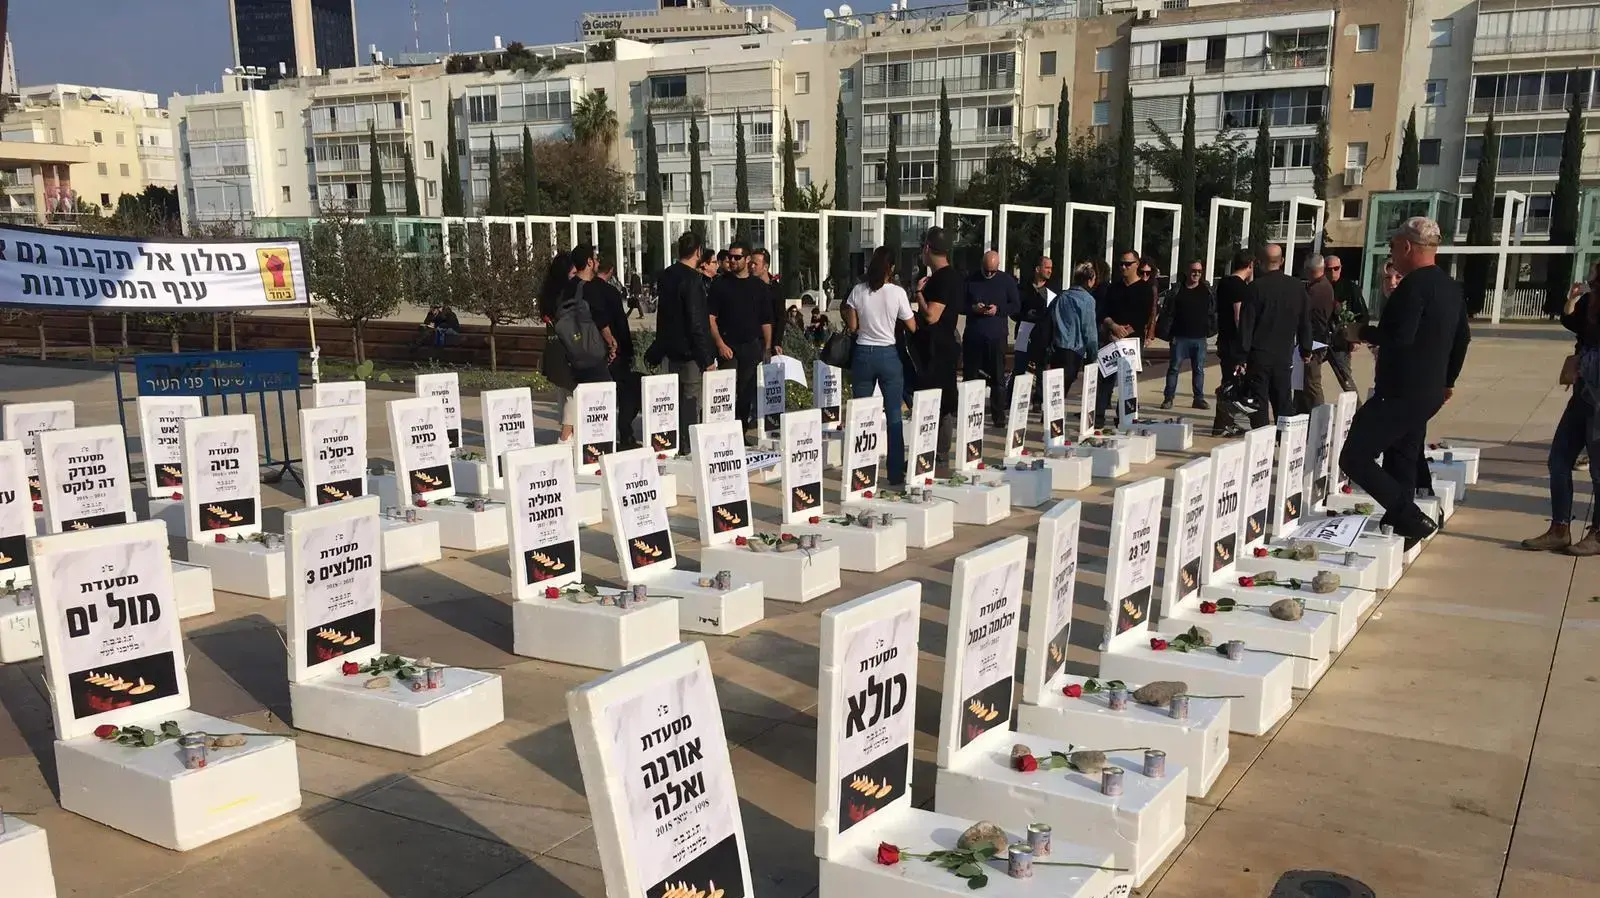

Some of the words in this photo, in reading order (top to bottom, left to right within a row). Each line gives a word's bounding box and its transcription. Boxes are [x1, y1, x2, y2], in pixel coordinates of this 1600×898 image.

[592, 19, 622, 30] Guesty
[16, 240, 48, 265] גם
[59, 245, 134, 274] תקבור
[139, 246, 173, 271] אל
[183, 248, 247, 276] כחלון
[21, 273, 156, 299] המסעדנות
[162, 281, 208, 304] ענף
[146, 378, 180, 392] העיר
[184, 376, 204, 389] פני
[411, 424, 434, 433] מסעדת
[323, 435, 349, 444] מסעדת
[411, 432, 437, 445] כתית
[68, 453, 104, 465] מסעדת
[208, 447, 240, 456] מסעדת
[714, 449, 734, 459] מסעדת
[68, 464, 107, 481] פונדק
[210, 459, 240, 472] בויה
[62, 478, 95, 495] לוקס
[98, 477, 116, 489] דה
[529, 478, 559, 491] מסעדת
[625, 479, 649, 490] מסעדת
[528, 492, 563, 508] אמיליה
[622, 496, 630, 507] 5
[630, 490, 657, 505] סינמה
[528, 506, 565, 523] רומאנה
[320, 542, 359, 560] מסעדת
[1129, 545, 1139, 562] 23
[320, 554, 372, 581] החלוצים
[80, 574, 139, 594] מסעדת
[306, 570, 316, 585] 3
[106, 592, 161, 630] מול
[979, 596, 1008, 618] מסעדת
[66, 603, 99, 639] ים
[989, 611, 1016, 636] יהלומה
[967, 624, 988, 646] בנמל
[859, 646, 898, 673] מסעדת
[845, 672, 908, 740] כולא
[640, 714, 693, 753] מסעדת
[640, 736, 704, 790] אורנה
[652, 770, 707, 821] ואלה
